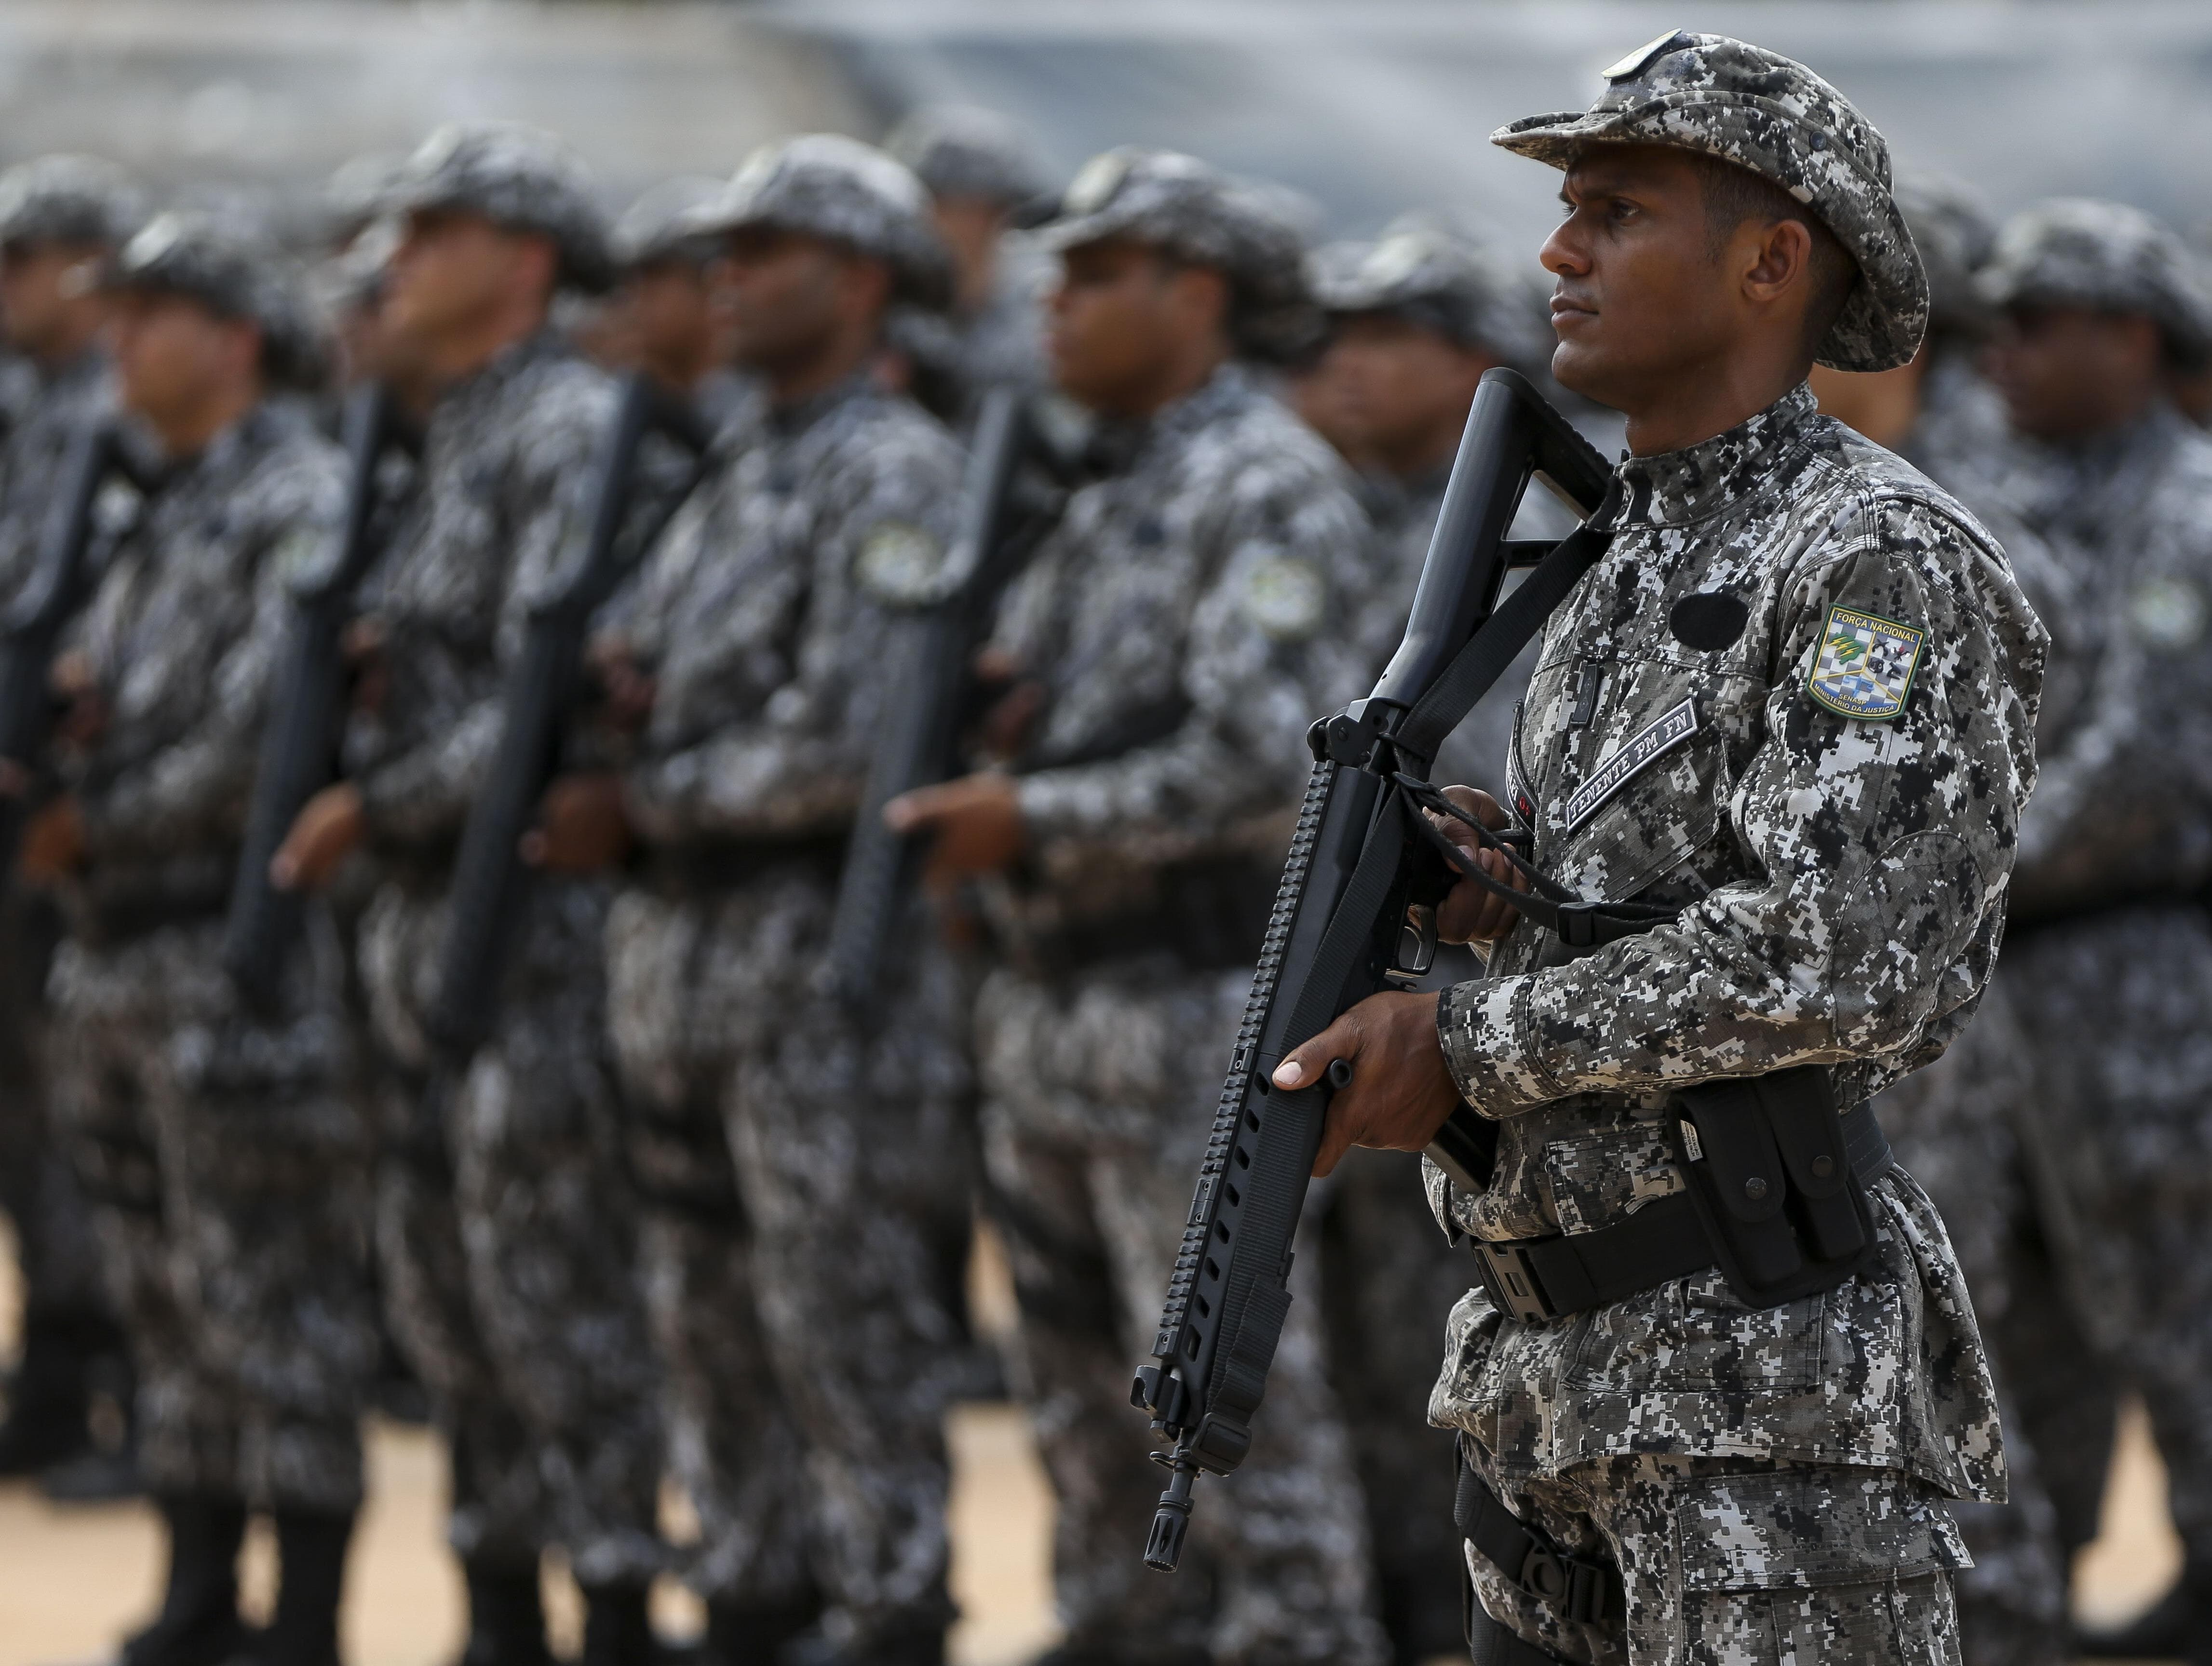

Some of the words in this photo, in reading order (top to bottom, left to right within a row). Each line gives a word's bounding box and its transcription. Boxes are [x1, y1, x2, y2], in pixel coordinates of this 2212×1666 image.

[1835, 612, 1867, 629] FORÇA
[1870, 622, 1916, 643] NACIONAL
[1838, 693, 1867, 706] SENASP
[1851, 705, 1863, 713] DA
[1570, 752, 1631, 819] TENENTE
[1635, 731, 1659, 761] PM
[1663, 711, 1687, 739] FN
